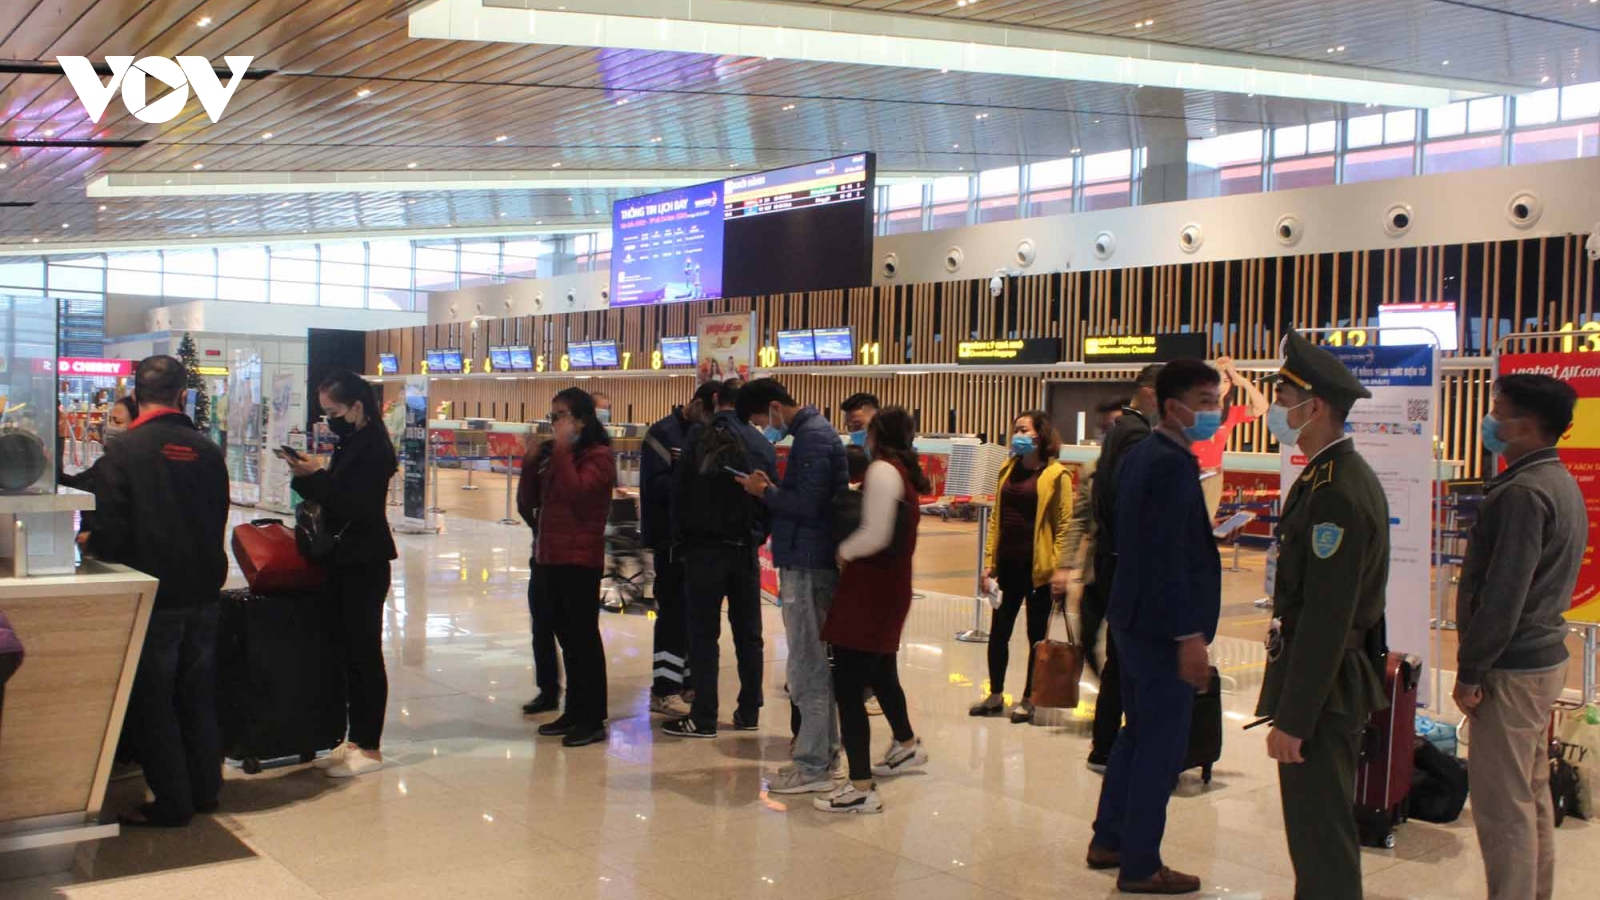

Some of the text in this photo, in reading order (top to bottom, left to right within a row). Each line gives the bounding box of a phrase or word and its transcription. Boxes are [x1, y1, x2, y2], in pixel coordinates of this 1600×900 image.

[621, 207, 645, 220] THÔNG
[646, 204, 657, 215] TIN
[658, 201, 673, 215] LỊCH
[674, 198, 688, 211] BAY
[1143, 336, 1155, 345] TIN
[1328, 330, 1367, 347] 12
[1560, 321, 1600, 353] 13
[622, 352, 631, 371] 7
[652, 350, 661, 370] 8
[759, 346, 776, 368] 10
[861, 342, 879, 365] 11
[43, 361, 121, 373] RD CHERRY
[378, 363, 383, 376] 1
[421, 360, 428, 375] 2
[463, 358, 472, 374] 3
[484, 357, 491, 373] 4
[536, 355, 544, 372] 5
[560, 354, 568, 371] 6
